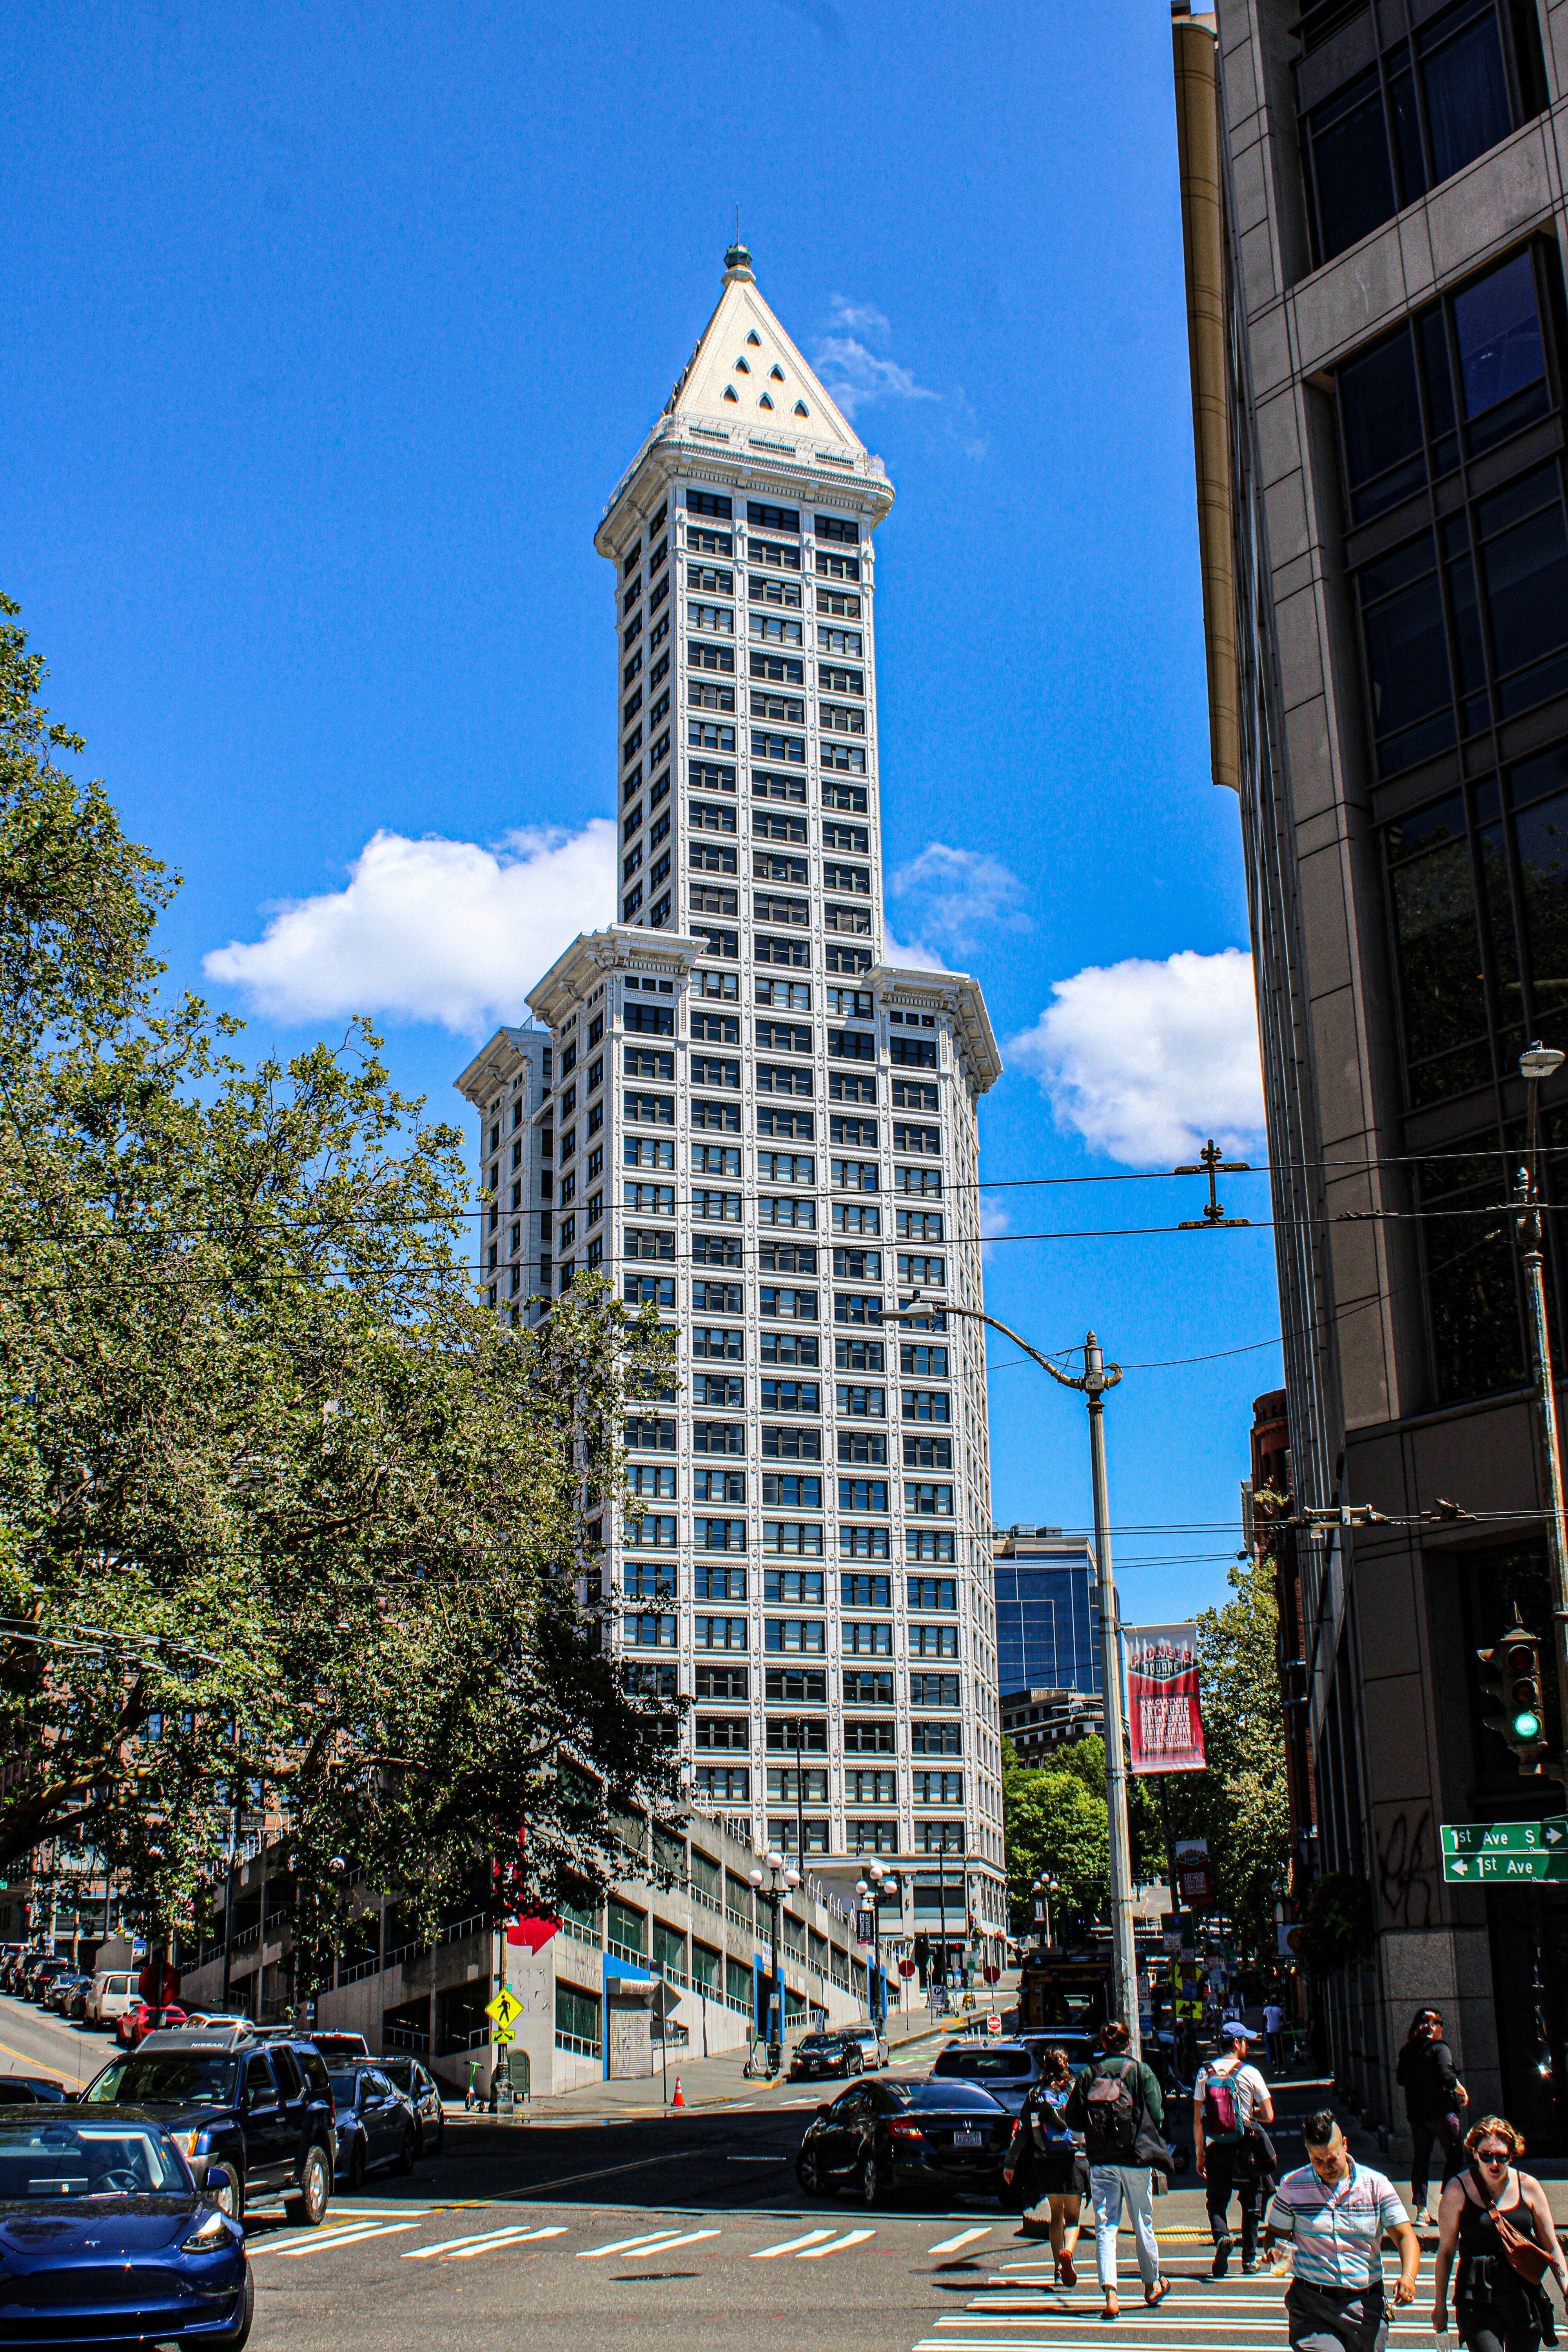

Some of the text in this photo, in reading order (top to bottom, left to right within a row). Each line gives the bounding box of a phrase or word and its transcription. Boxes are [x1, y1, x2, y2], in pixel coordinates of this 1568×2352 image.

[1131, 1645, 1192, 1666] PIONEER
[1144, 1661, 1179, 1675] SQUARE
[1142, 1736, 1160, 1744] HIDDEN
[1451, 1829, 1535, 1849] 1st Ave S
[1476, 1857, 1533, 1877] 1st Ave
